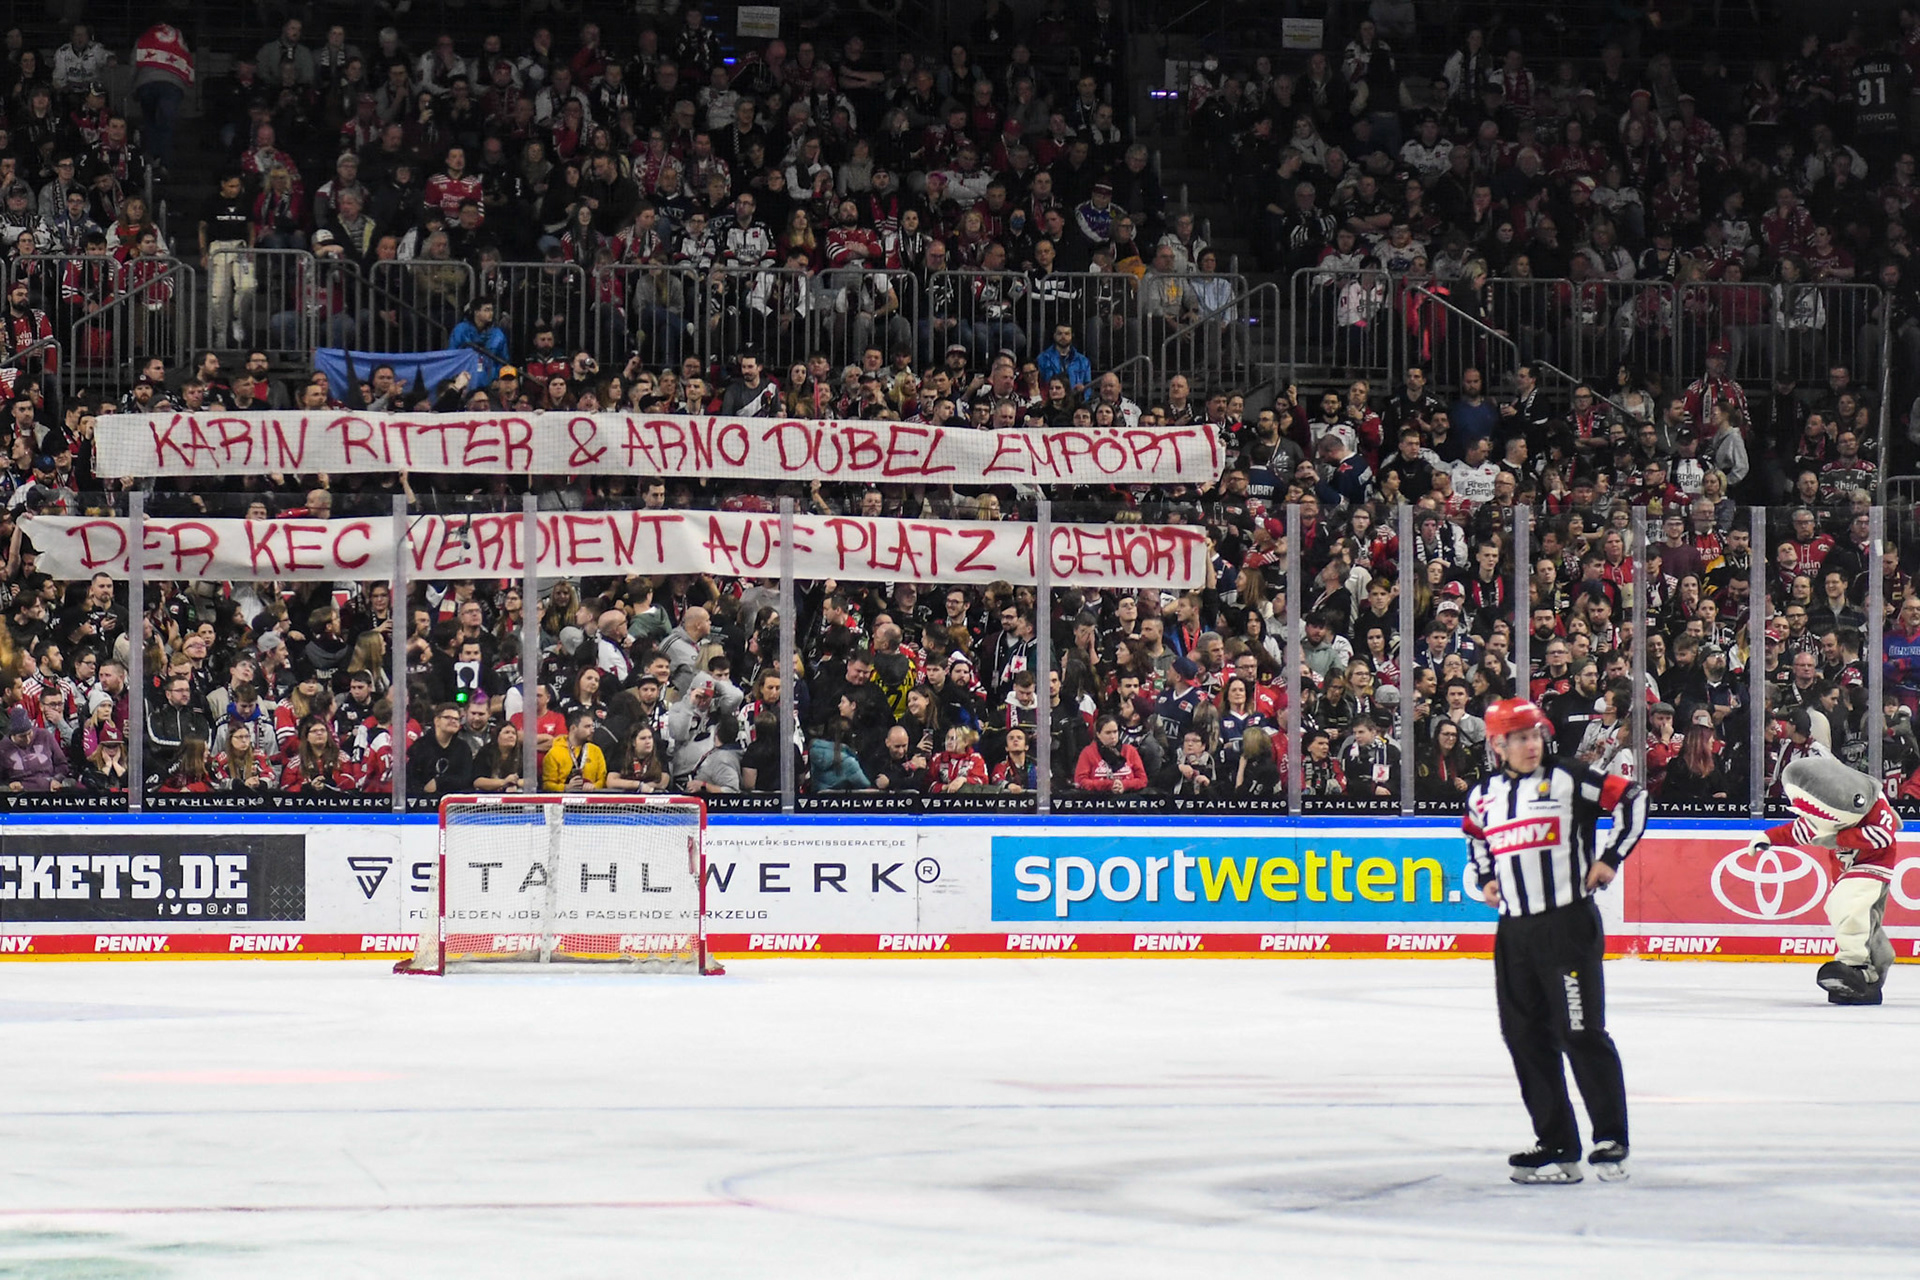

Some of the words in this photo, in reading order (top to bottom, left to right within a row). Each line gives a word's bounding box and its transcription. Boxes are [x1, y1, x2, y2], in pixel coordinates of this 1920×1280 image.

[1858, 78, 1887, 106] 91
[149, 414, 309, 470] KARIN
[325, 416, 534, 471] RITTER
[568, 417, 607, 468] &
[621, 415, 751, 473] ARNO
[762, 420, 957, 477] DÜBEL
[66, 520, 221, 575] DER
[245, 522, 371, 575] KEC
[406, 512, 684, 573] VERDIENT
[702, 516, 814, 574] AUF
[823, 518, 997, 578] PLATZ
[1050, 524, 1208, 581] GEHÖRT
